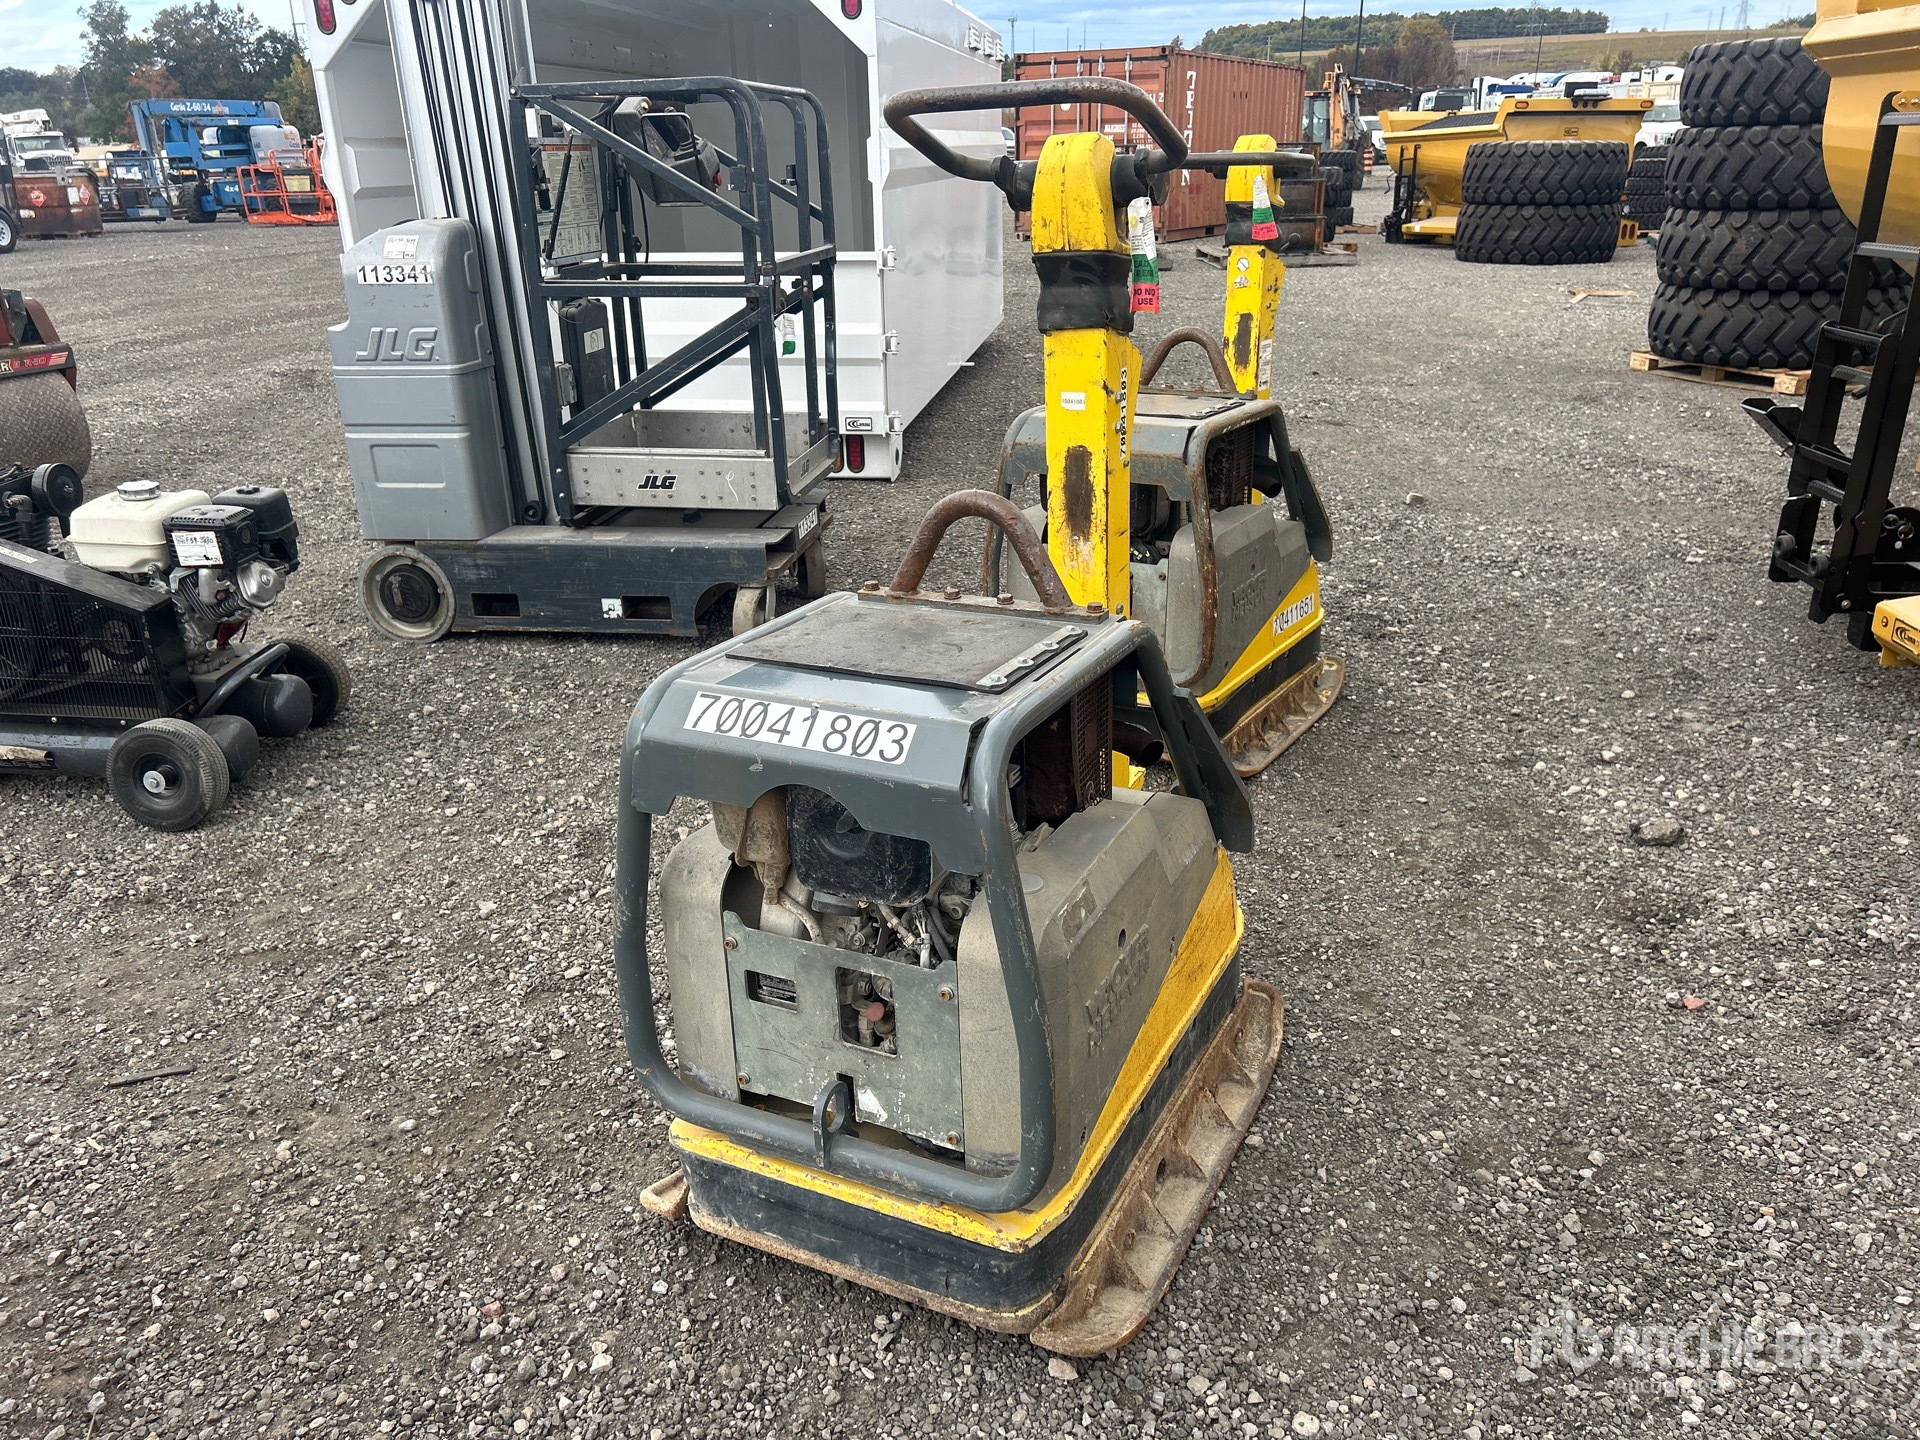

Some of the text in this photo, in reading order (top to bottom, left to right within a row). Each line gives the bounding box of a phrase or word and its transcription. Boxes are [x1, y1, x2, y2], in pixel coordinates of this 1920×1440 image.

[224, 184, 240, 193] 4x4
[358, 265, 431, 283] 113341
[1137, 297, 1154, 306] USE
[638, 474, 677, 491] JLG
[690, 692, 909, 763] 70041803
